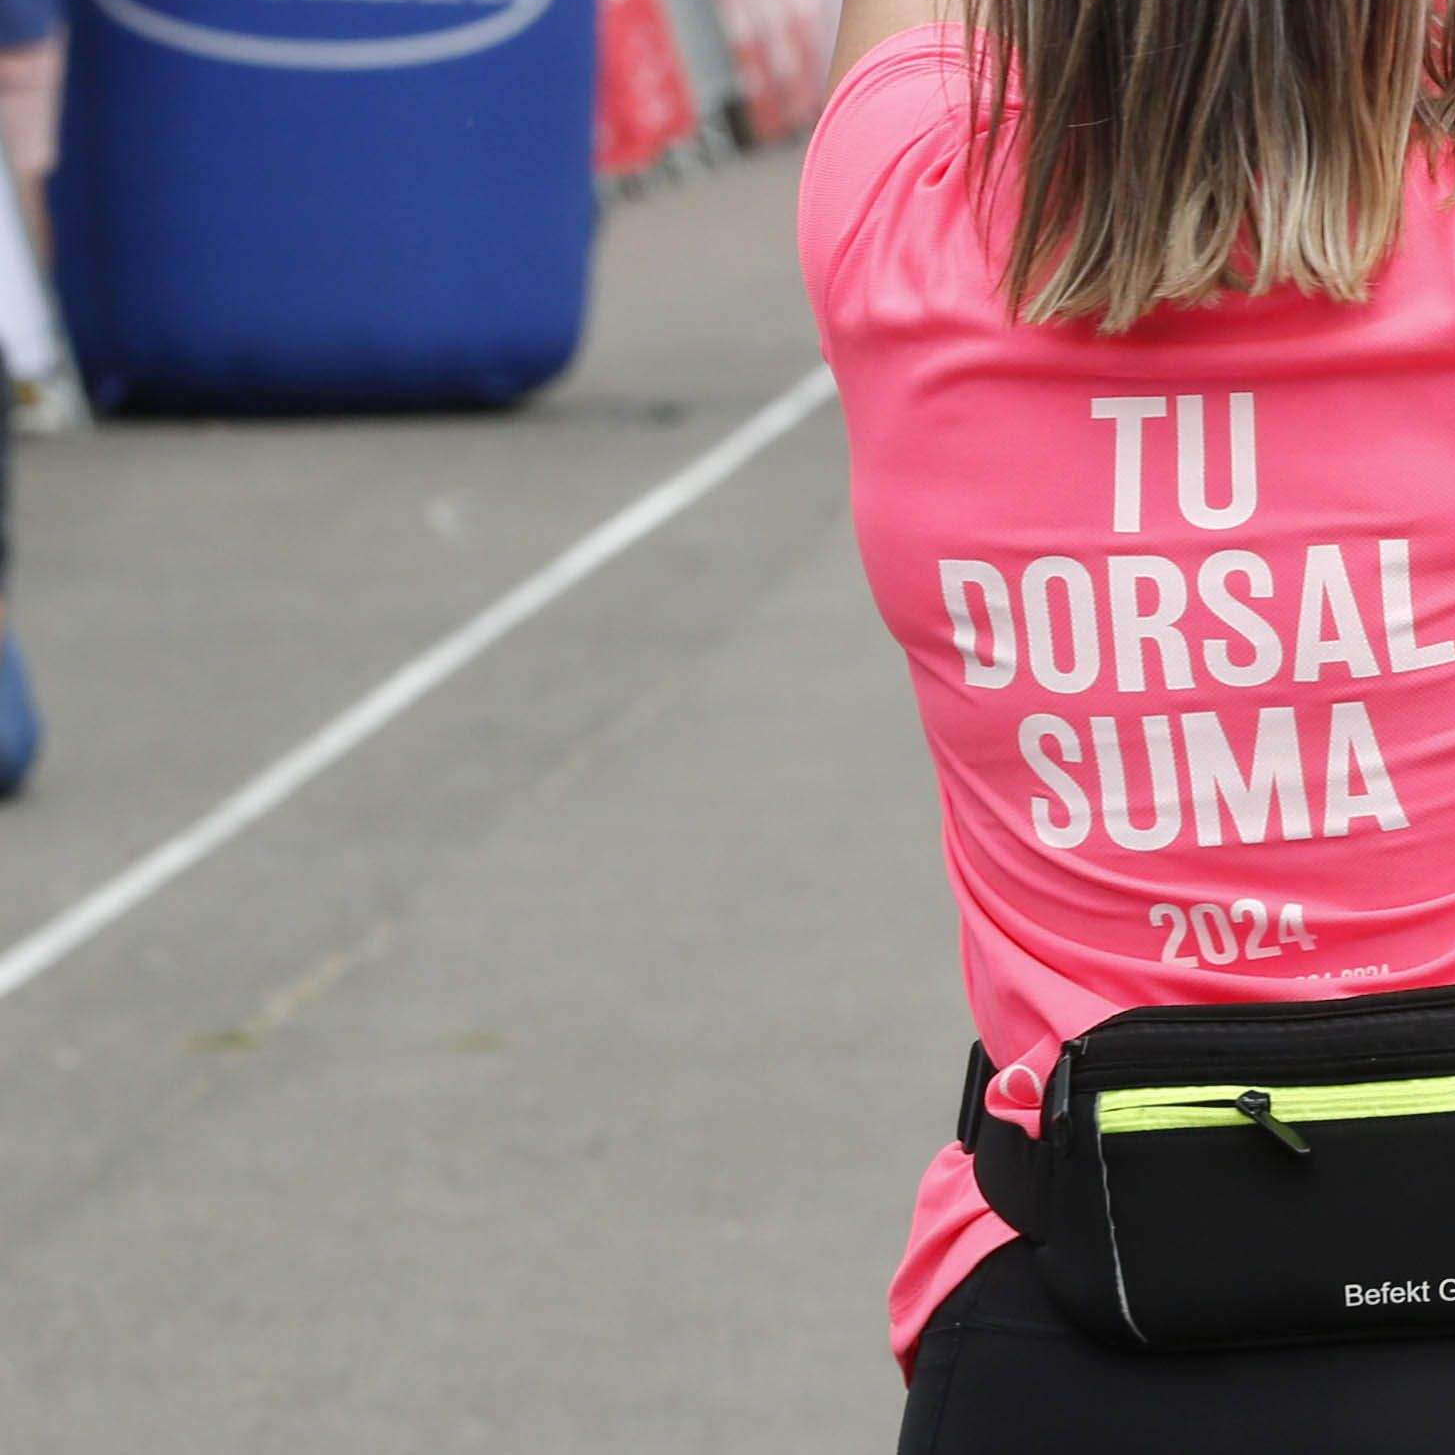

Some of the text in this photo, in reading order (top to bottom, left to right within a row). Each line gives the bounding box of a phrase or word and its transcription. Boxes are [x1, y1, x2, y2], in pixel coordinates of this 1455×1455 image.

[1090, 391, 1259, 533] TU
[1016, 700, 1412, 852] SUMA
[1149, 898, 1318, 969] 2024
[1344, 1280, 1431, 1308] Befekt
